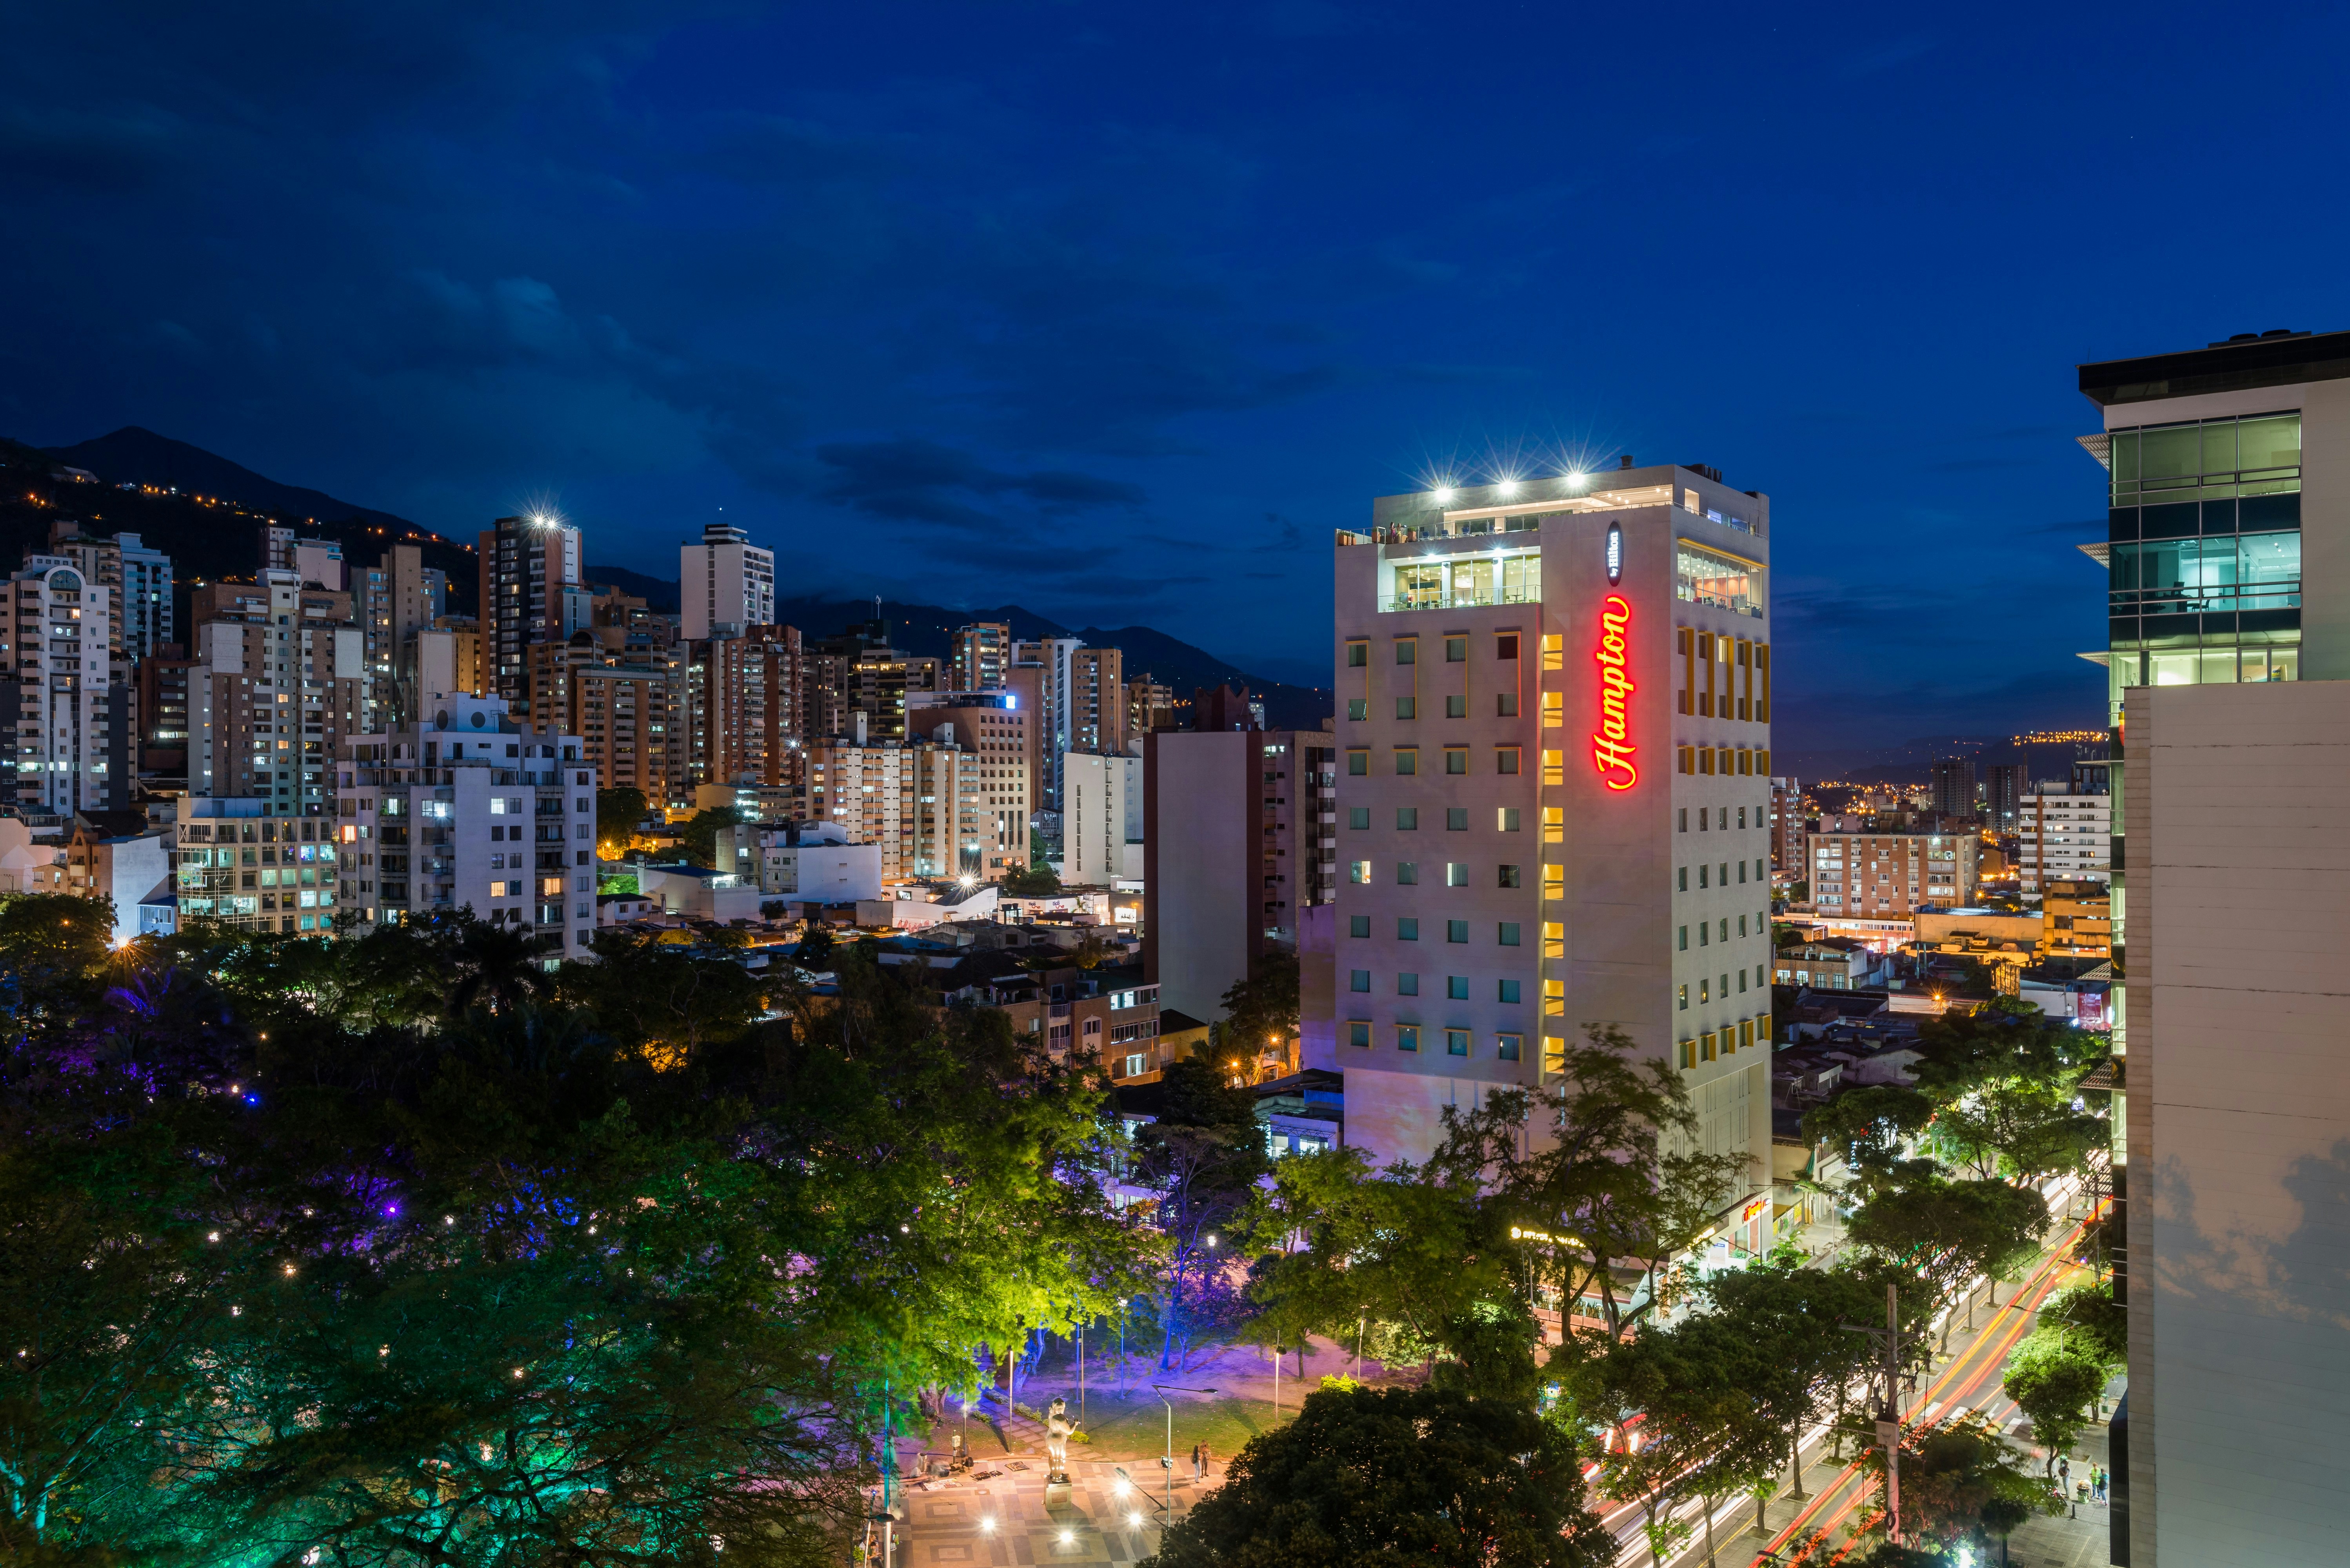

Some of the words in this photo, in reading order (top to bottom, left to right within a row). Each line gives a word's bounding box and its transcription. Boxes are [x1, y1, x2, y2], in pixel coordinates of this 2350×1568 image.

[1608, 532, 1618, 568] Hilton
[1610, 568, 1618, 577] by
[1593, 597, 1636, 789] Hampton
